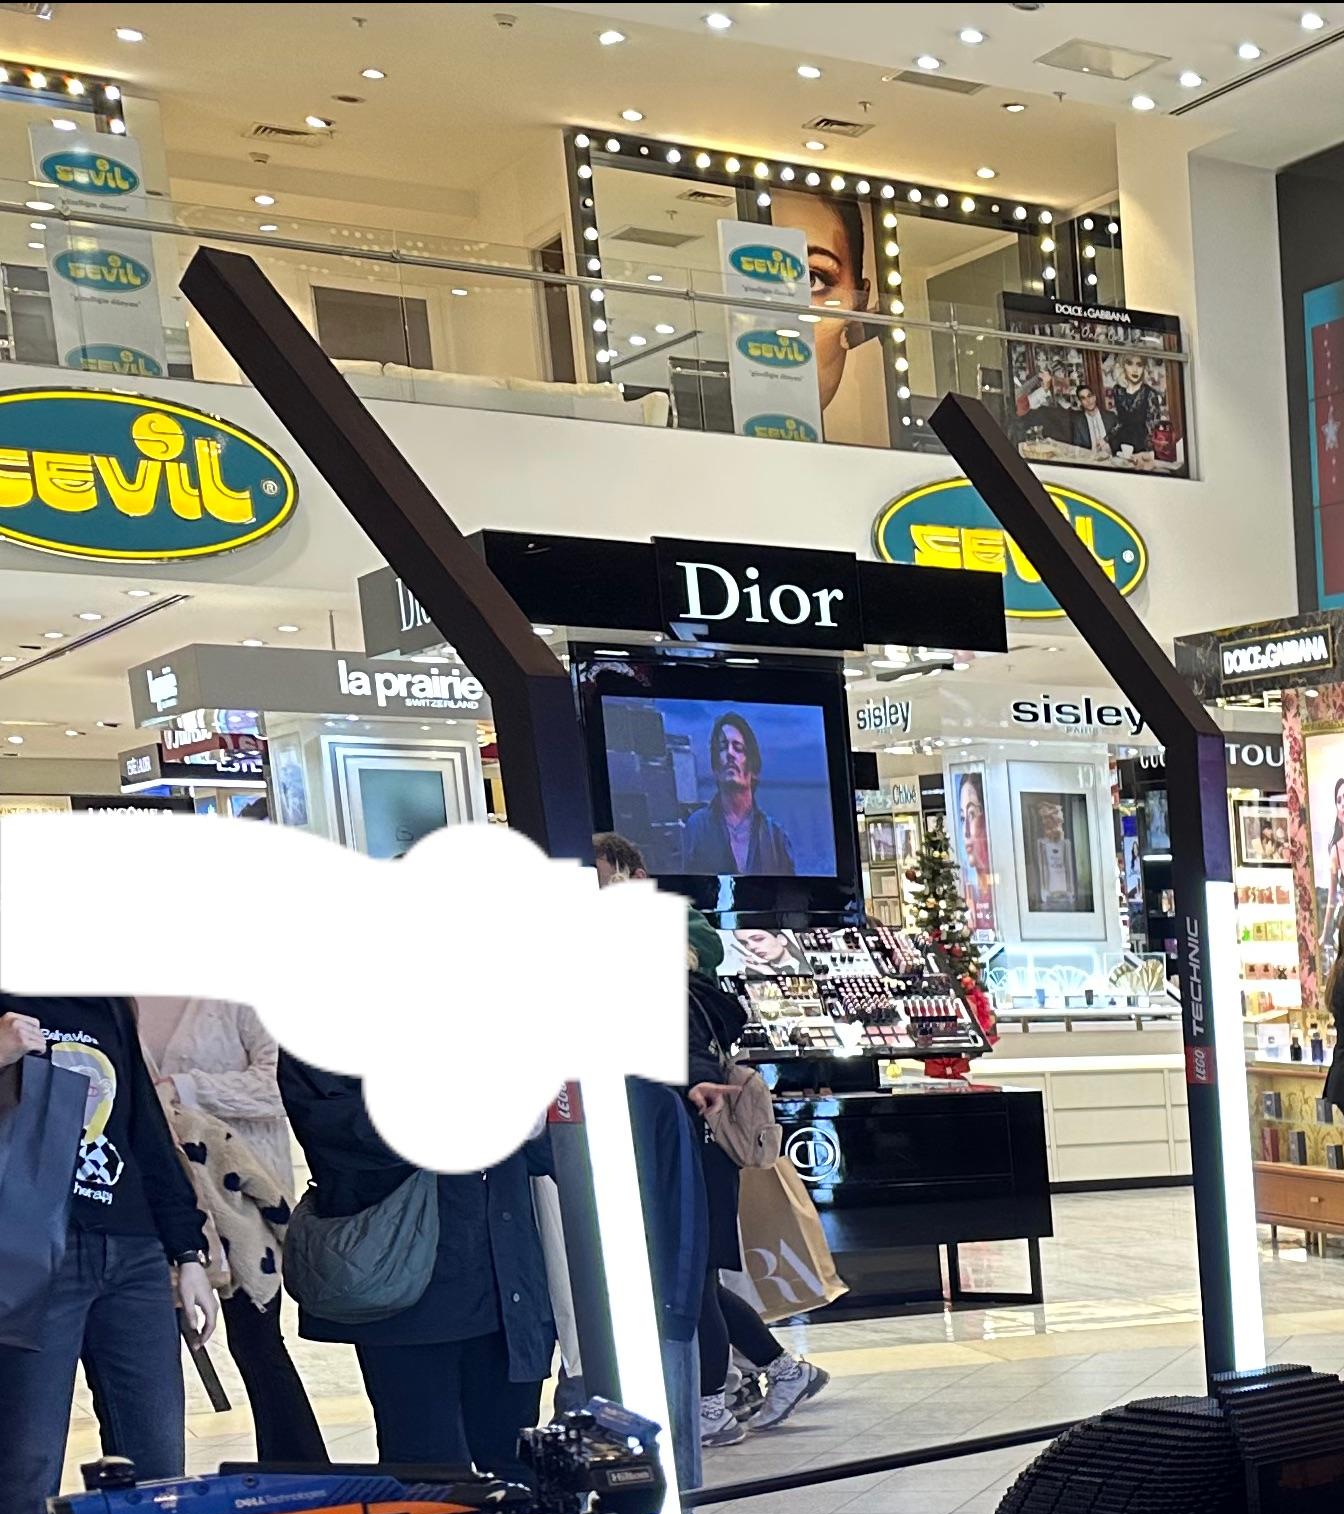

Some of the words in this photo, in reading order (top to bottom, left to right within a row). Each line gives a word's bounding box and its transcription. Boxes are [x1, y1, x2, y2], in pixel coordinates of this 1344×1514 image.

[675, 560, 844, 629] Dior
[337, 659, 372, 696] la
[374, 667, 484, 708] prairie
[856, 696, 912, 733] sisley
[1011, 693, 1145, 736] sisley
[1186, 915, 1206, 1037] TECHNIC
[1194, 1048, 1207, 1082] LEGO
